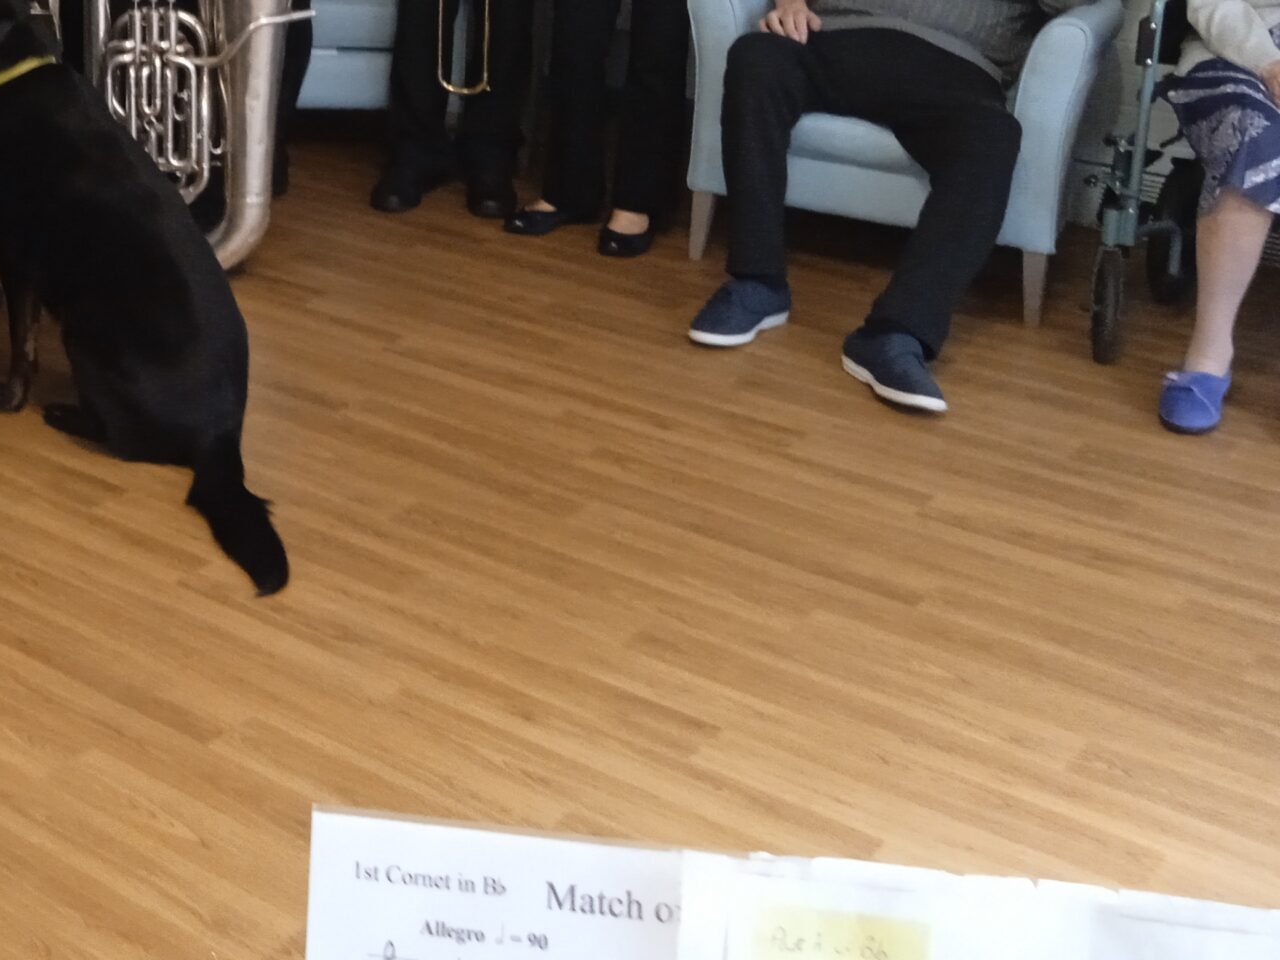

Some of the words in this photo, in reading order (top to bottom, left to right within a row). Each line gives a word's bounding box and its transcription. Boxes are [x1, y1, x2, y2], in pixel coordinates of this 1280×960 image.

[354, 860, 380, 883] 1st
[385, 863, 452, 891] Cornet
[457, 872, 477, 894] in
[545, 880, 644, 921] Match
[654, 901, 681, 924] o
[420, 919, 486, 944] Allegro
[527, 932, 549, 951] 90
